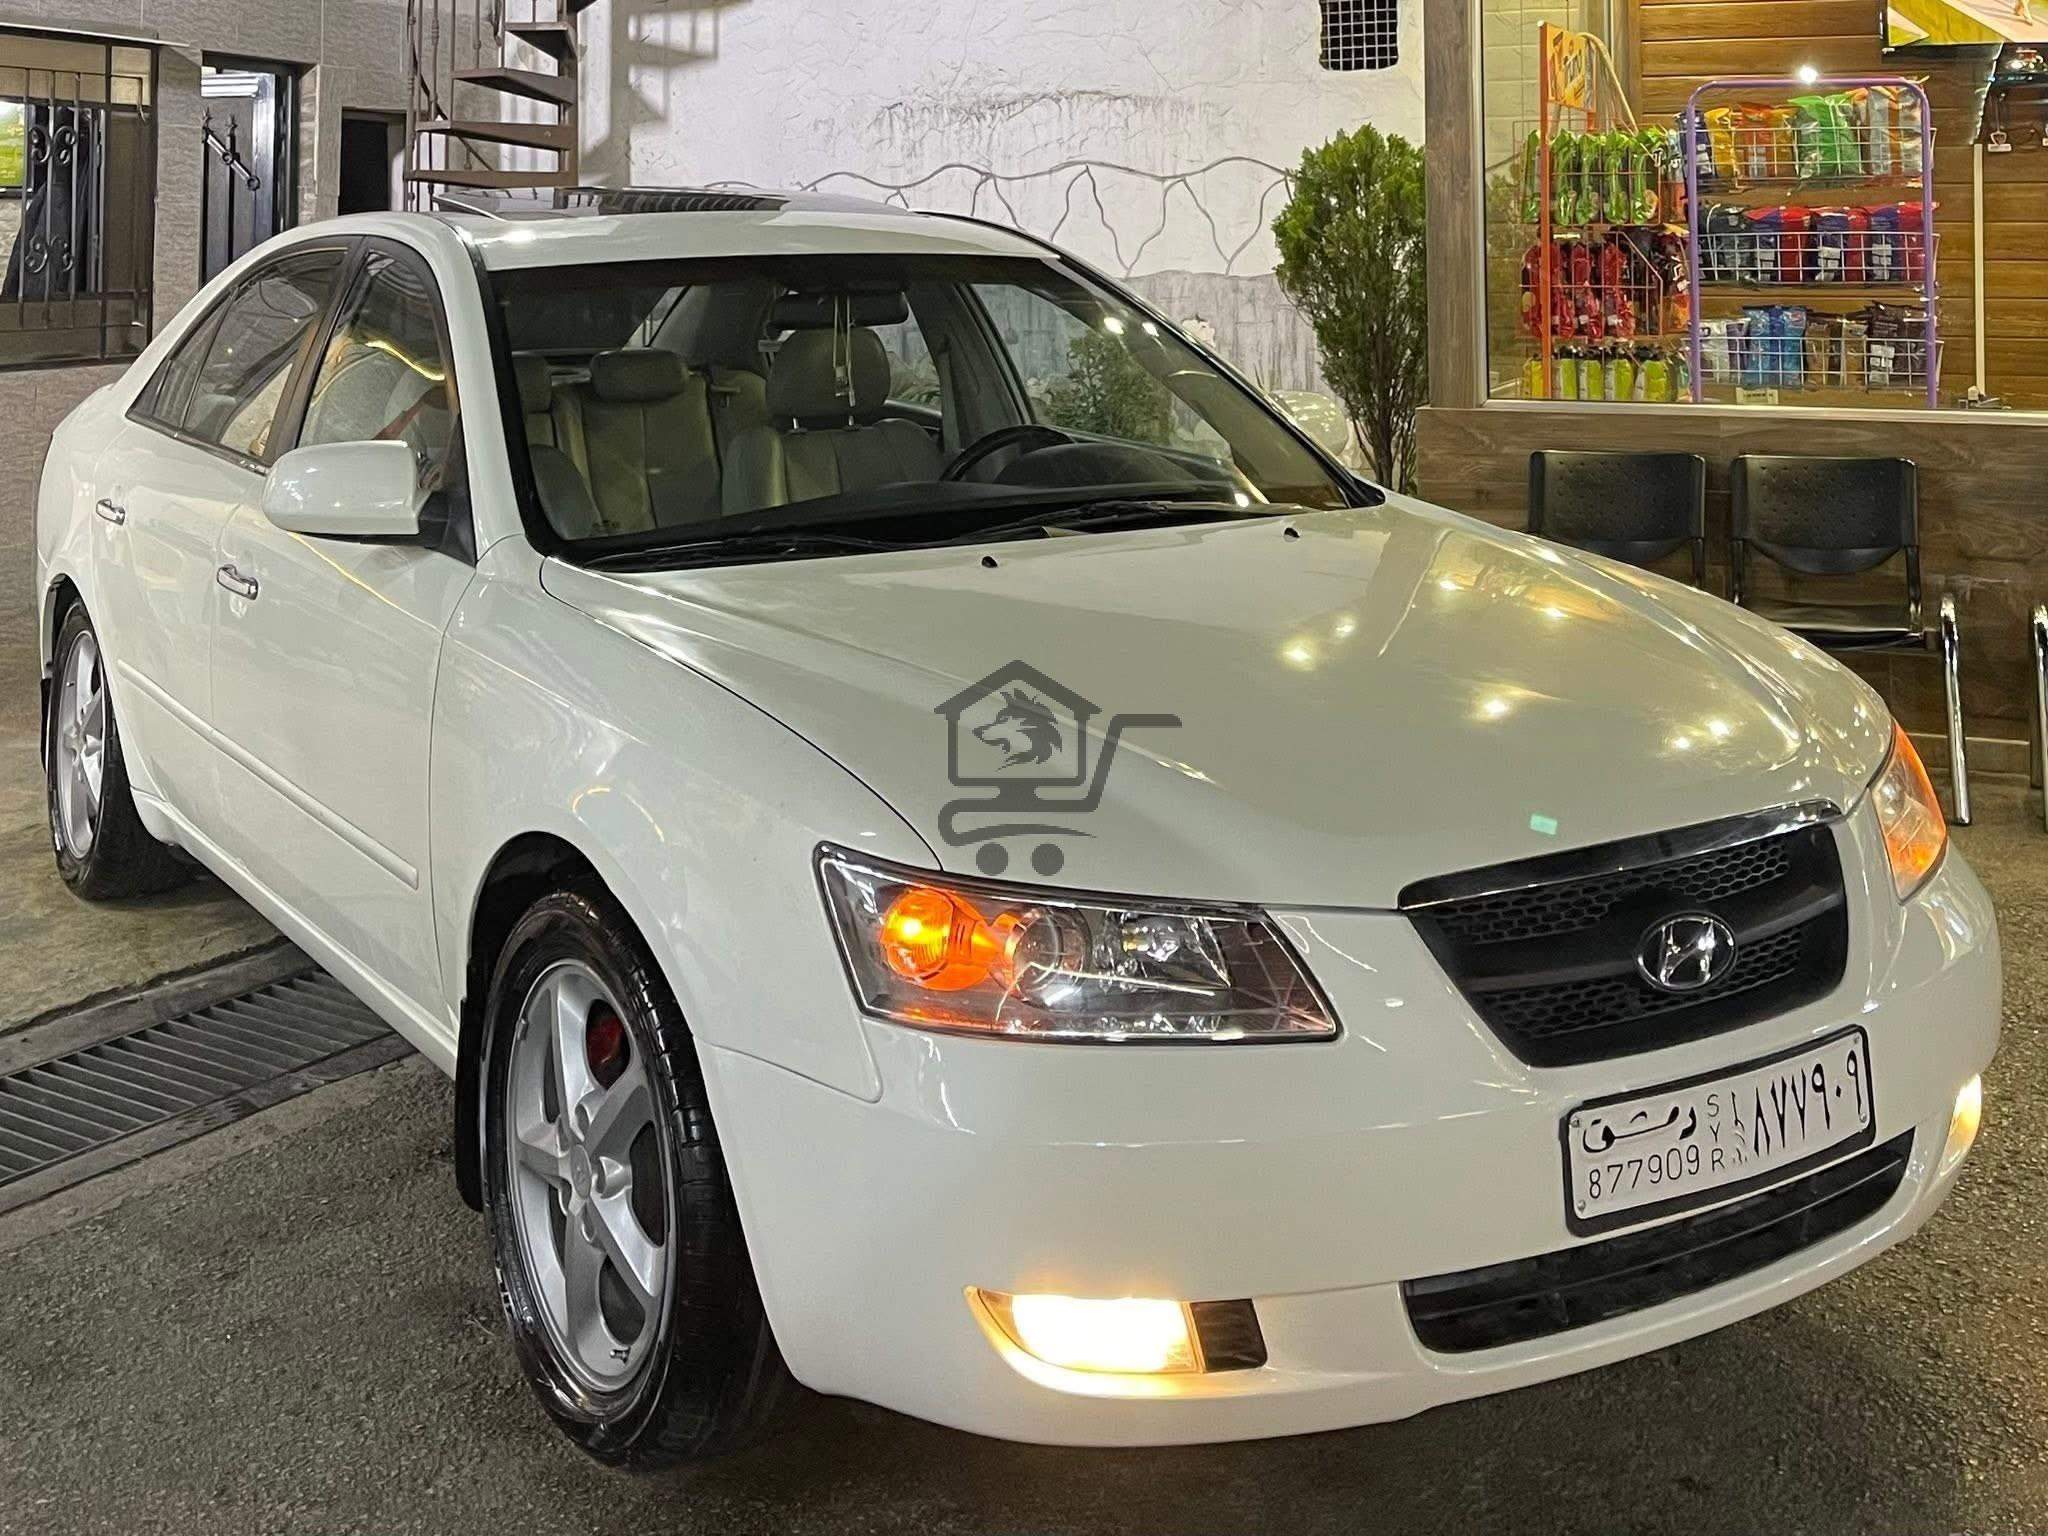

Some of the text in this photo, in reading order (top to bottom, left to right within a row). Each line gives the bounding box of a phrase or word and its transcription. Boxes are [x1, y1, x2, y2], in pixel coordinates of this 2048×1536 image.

[1582, 1105, 1698, 1154] دمشق
[1754, 1050, 1863, 1158] ٨٧٧٩٠٩
[1588, 1144, 1701, 1200] 877909
